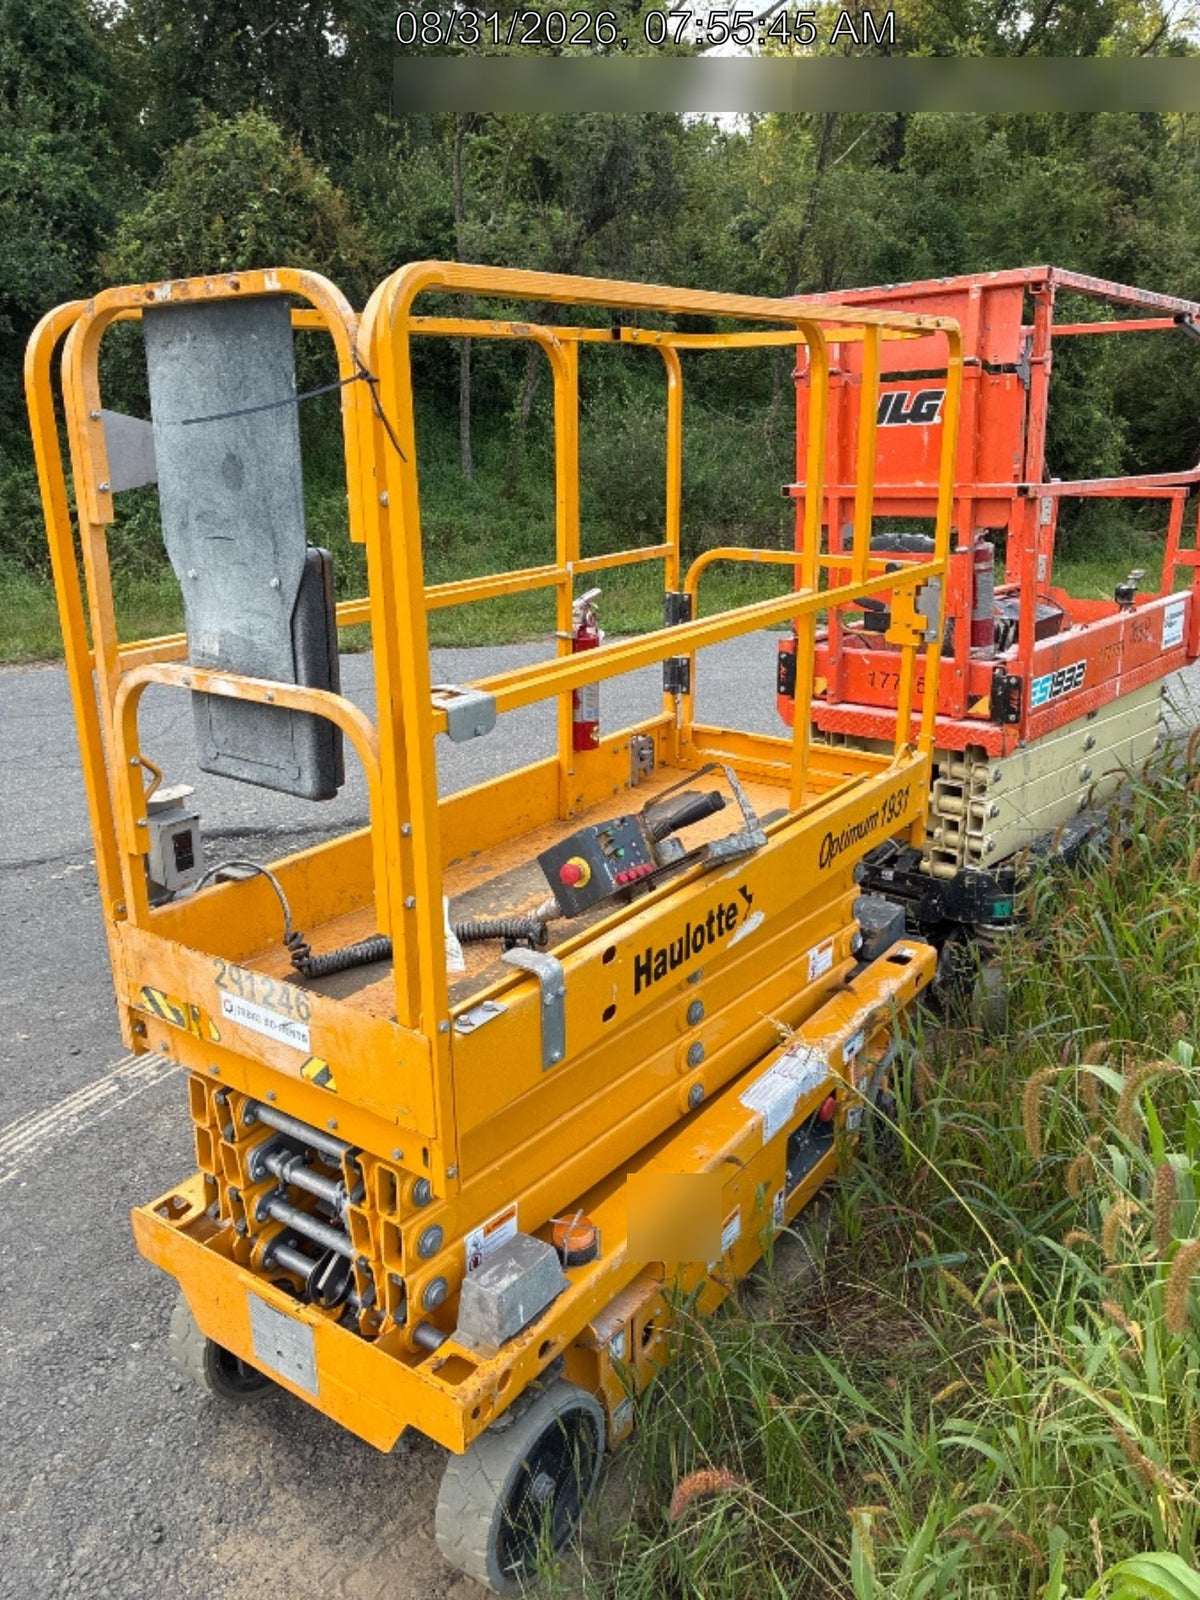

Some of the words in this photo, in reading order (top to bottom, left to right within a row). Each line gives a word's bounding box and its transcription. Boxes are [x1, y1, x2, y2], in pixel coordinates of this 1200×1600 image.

[1031, 662, 1086, 707] ES1932
[819, 811, 879, 869] Optimum
[881, 783, 911, 827] 1931
[634, 902, 738, 996] Haulotte
[213, 957, 312, 1022] 291246
